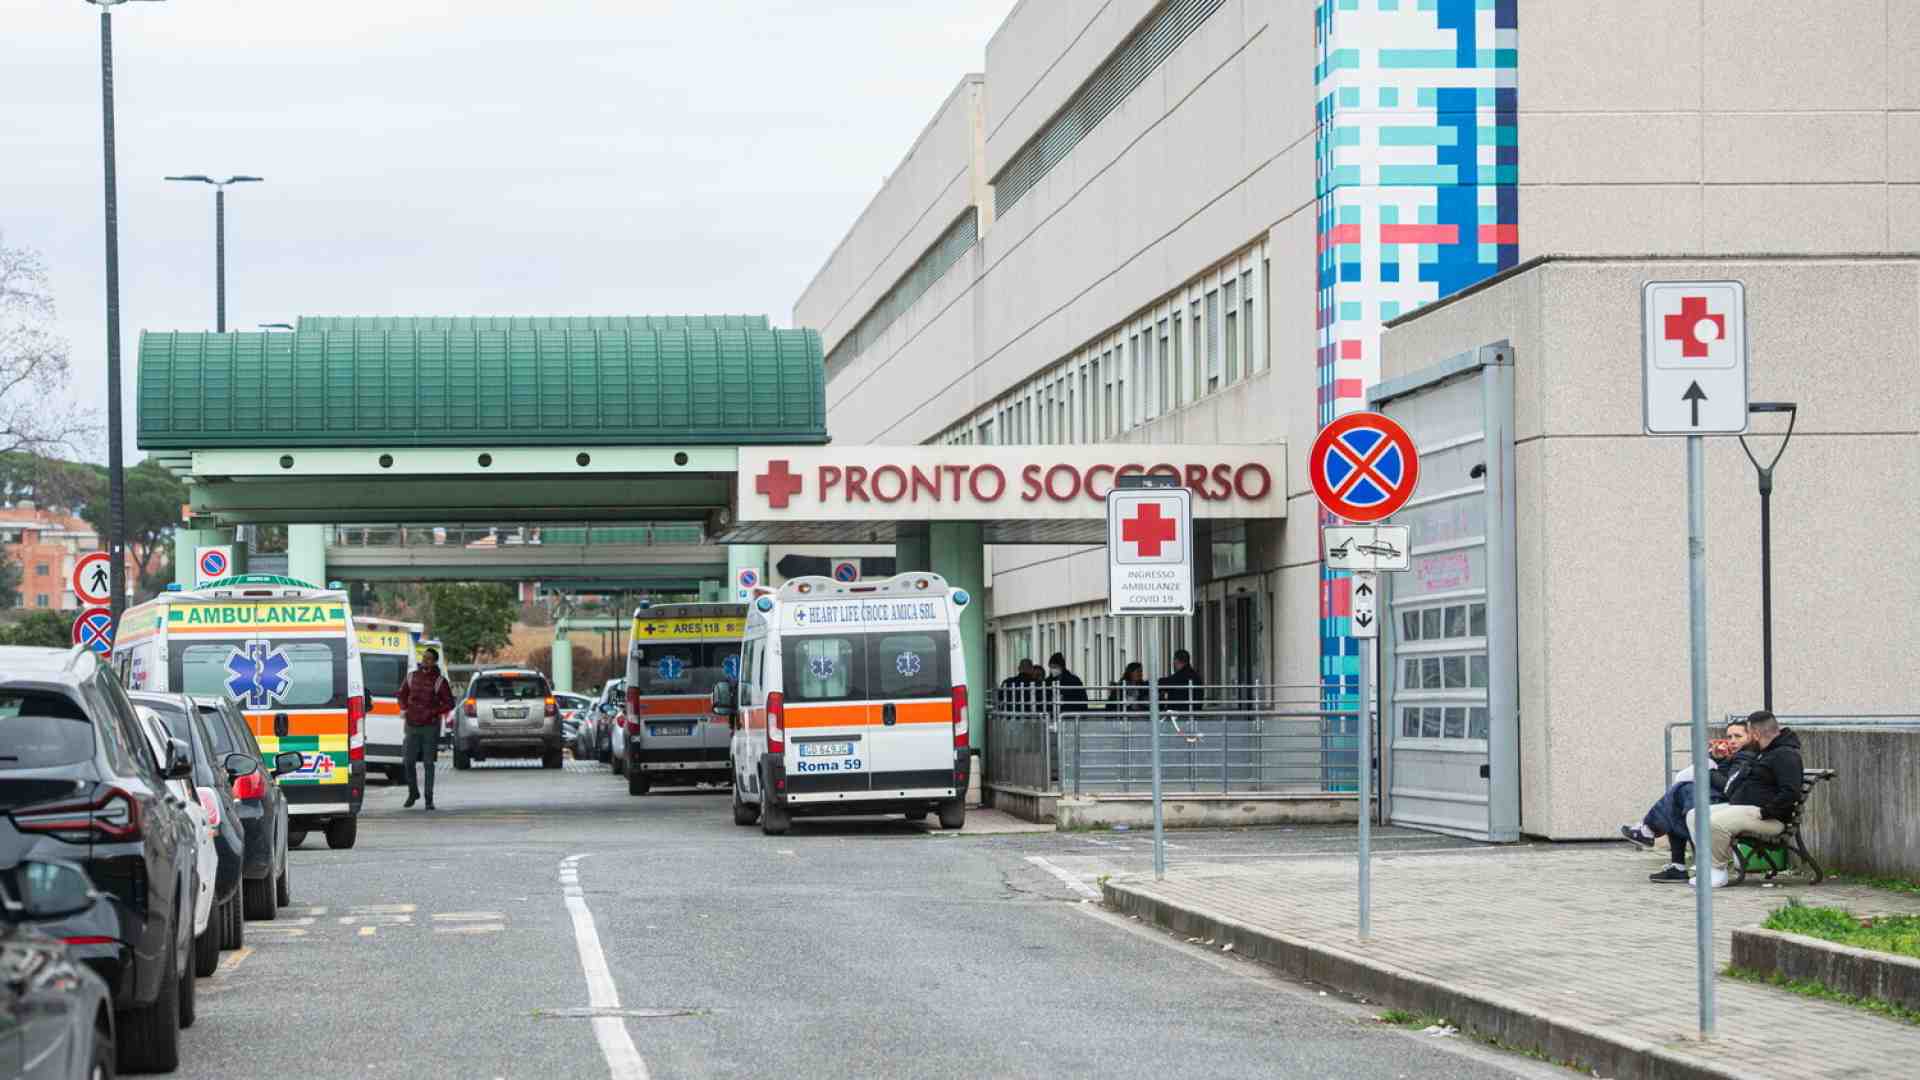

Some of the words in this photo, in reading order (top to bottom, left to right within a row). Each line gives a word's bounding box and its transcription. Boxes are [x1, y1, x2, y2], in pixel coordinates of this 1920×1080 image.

[818, 464, 1006, 503] PRONTO
[1128, 570, 1175, 578] INGRESSO
[1121, 583, 1180, 591] AMBULANZE
[1129, 595, 1159, 603] COVID
[1163, 595, 1174, 603] 19
[188, 607, 326, 624] AMBULANZA
[809, 606, 838, 623] HEART
[840, 605, 859, 622] LIFE
[861, 604, 889, 621] CROCE
[891, 603, 917, 620] AMICA
[673, 624, 701, 633] ARES
[704, 623, 719, 633] 118
[381, 636, 401, 647] 118
[797, 761, 839, 772] Roma
[844, 759, 862, 770] 59
